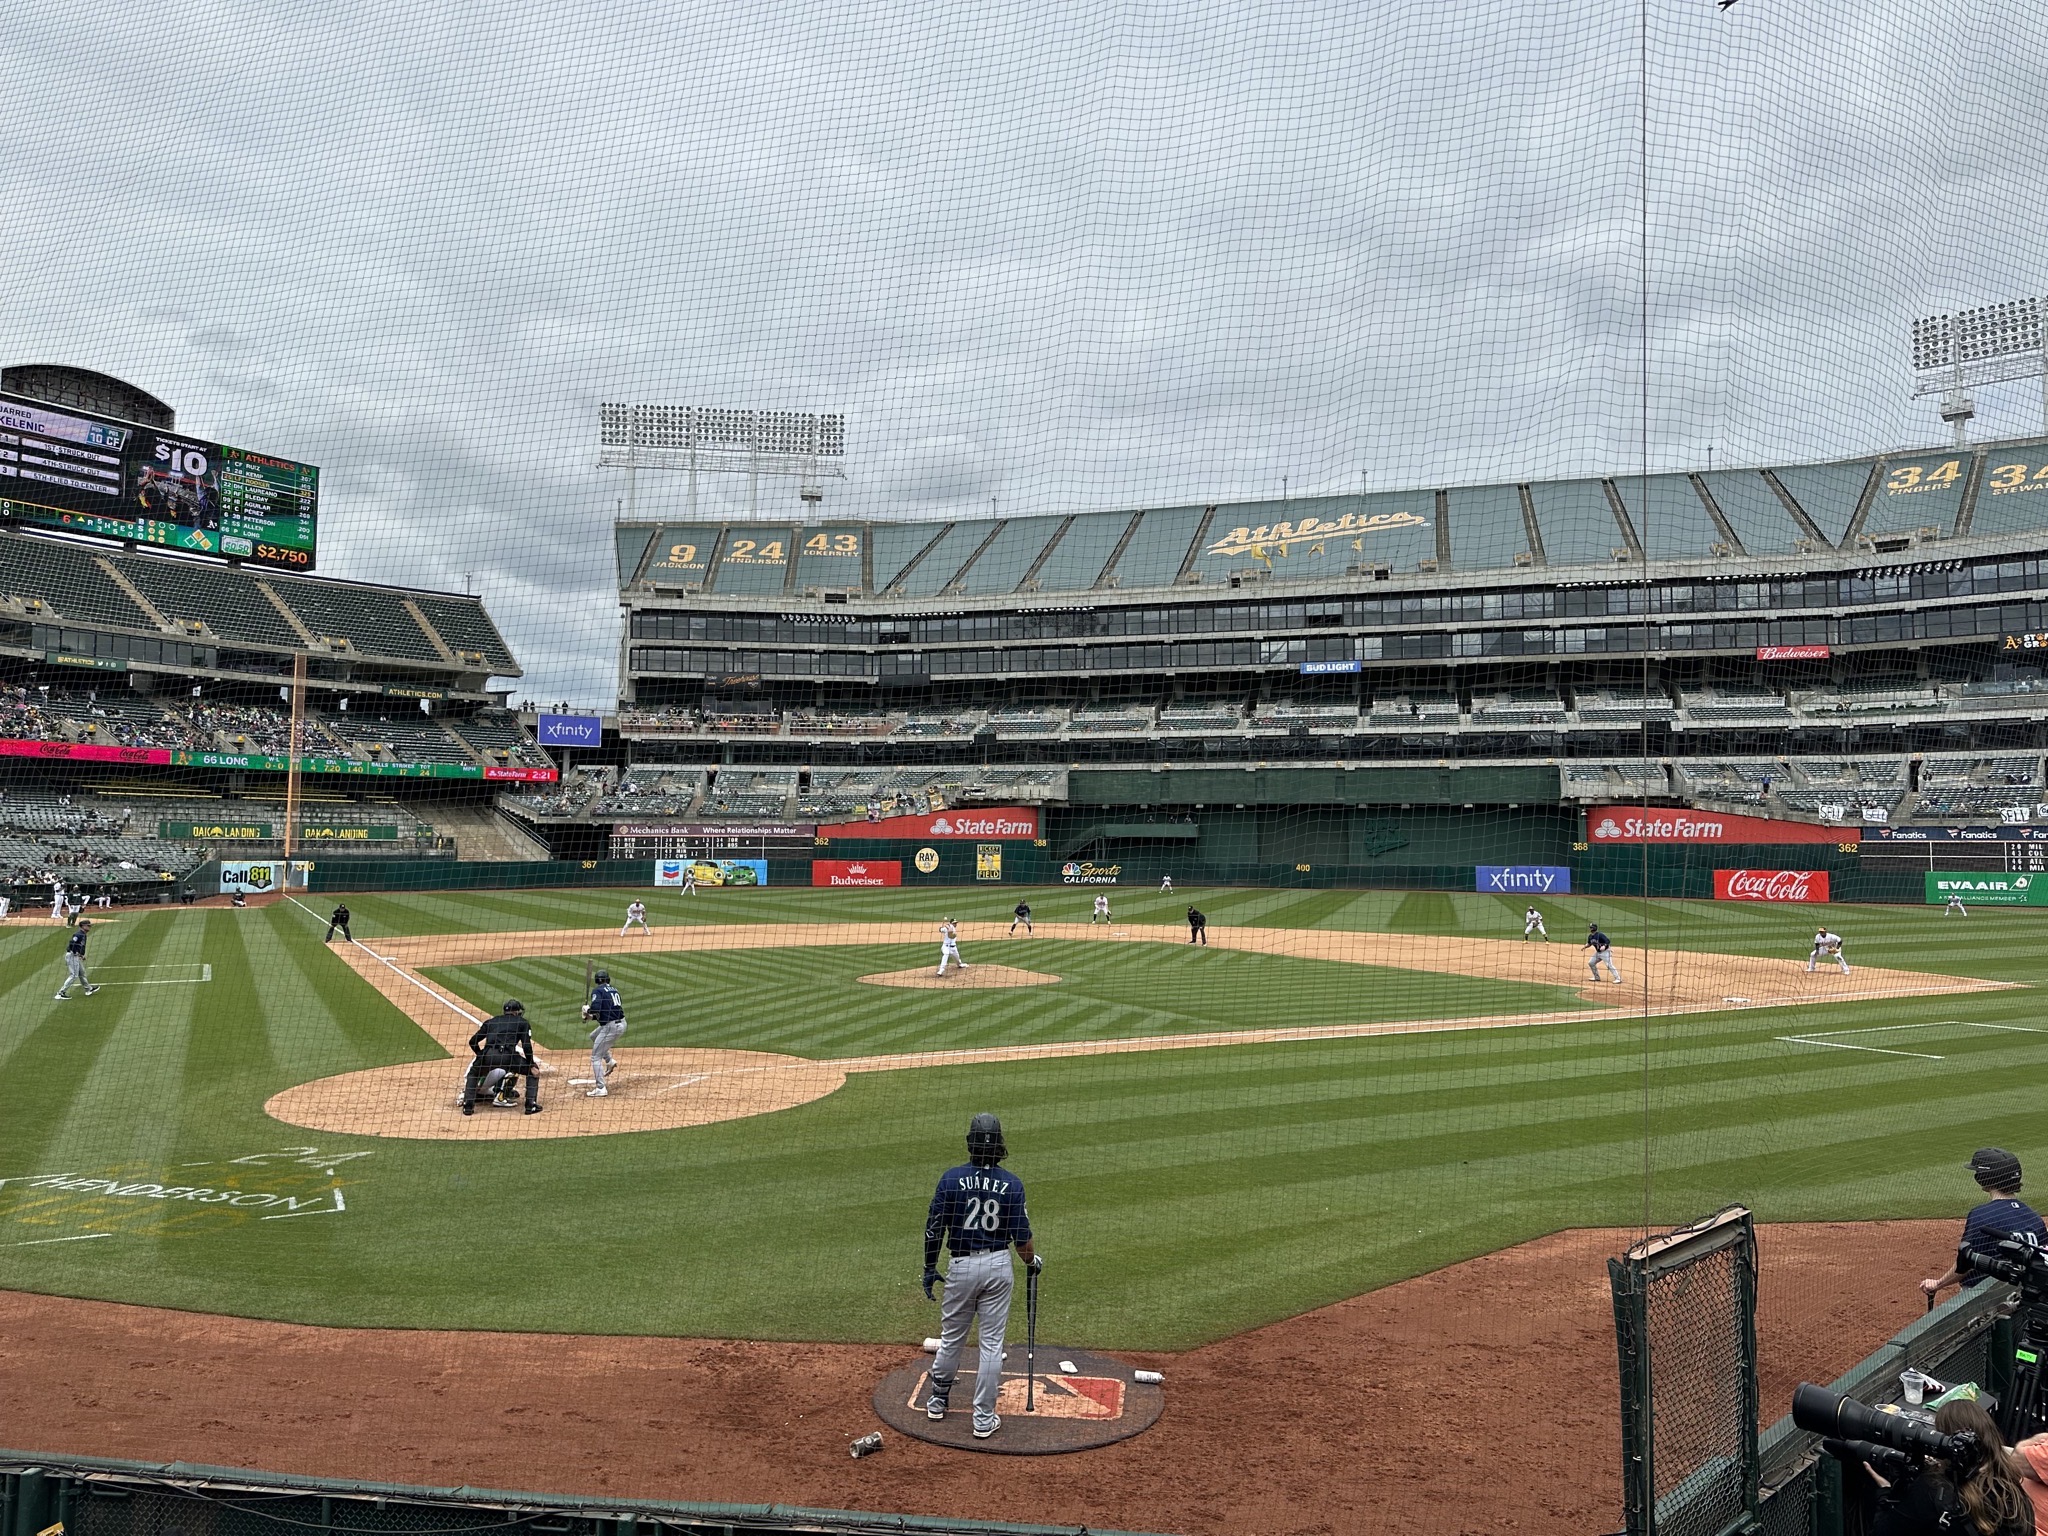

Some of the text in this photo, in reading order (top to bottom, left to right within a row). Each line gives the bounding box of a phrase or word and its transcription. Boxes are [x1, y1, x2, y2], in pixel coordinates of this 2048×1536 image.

[0, 405, 32, 419] JARRED
[0, 416, 45, 432] KELENIC
[90, 432, 120, 447] 10 CF
[156, 436, 180, 446] TICKETS
[155, 443, 207, 476] $10
[246, 454, 294, 471] ATHLETICS
[87, 468, 100, 476] OUT
[1888, 461, 1962, 489] 34
[81, 483, 107, 492] CENTER
[245, 486, 278, 497] LAUREANO
[1889, 482, 1951, 496] FINGERS
[1993, 483, 2048, 495] STEWA
[245, 494, 268, 502] BLEDAY
[245, 502, 270, 510] AGUILAR
[62, 515, 71, 524] 6
[244, 516, 275, 526] PETERSON
[1206, 511, 1426, 554] Athletics
[806, 533, 858, 551] 43
[257, 543, 308, 564] $2,750
[669, 544, 696, 563] 9
[731, 540, 784, 559] 24
[803, 550, 859, 558] ECKERSLEY
[723, 557, 787, 565] HENDERSON
[1760, 647, 1826, 659] Budweiser
[1306, 662, 1355, 672] BUD LIGHT
[389, 688, 443, 699] ATHLETICS.COM
[547, 724, 592, 739] xfinity
[203, 755, 248, 766] 66 LONG
[532, 771, 550, 779] 2:21
[193, 826, 260, 838] OAK LANDING
[305, 829, 321, 838] OAK
[630, 826, 669, 834] Mechanics
[727, 827, 772, 835] Relationships
[1892, 831, 1927, 839] Fanatics
[1961, 831, 1997, 839] Fanatics
[814, 837, 829, 846] 362
[1839, 843, 1857, 852] 362
[920, 853, 935, 862] RAY
[582, 860, 597, 869] 367
[1080, 862, 1121, 876] Sports
[1296, 864, 1310, 872] 400
[222, 866, 271, 884] Call 811
[978, 870, 999, 878] FIELD
[1490, 868, 1555, 891] xfinity
[830, 875, 883, 885] Budweiser
[1064, 876, 1116, 884] CALIFORNIA
[1727, 870, 1813, 899] Coca-Cola
[1937, 881, 2008, 891] EVA AIR
[610, 992, 621, 1006] 10
[959, 1171, 1009, 1195] SUÁREZ
[30, 1177, 323, 1210] HENDERSON
[963, 1196, 1000, 1232] 28
